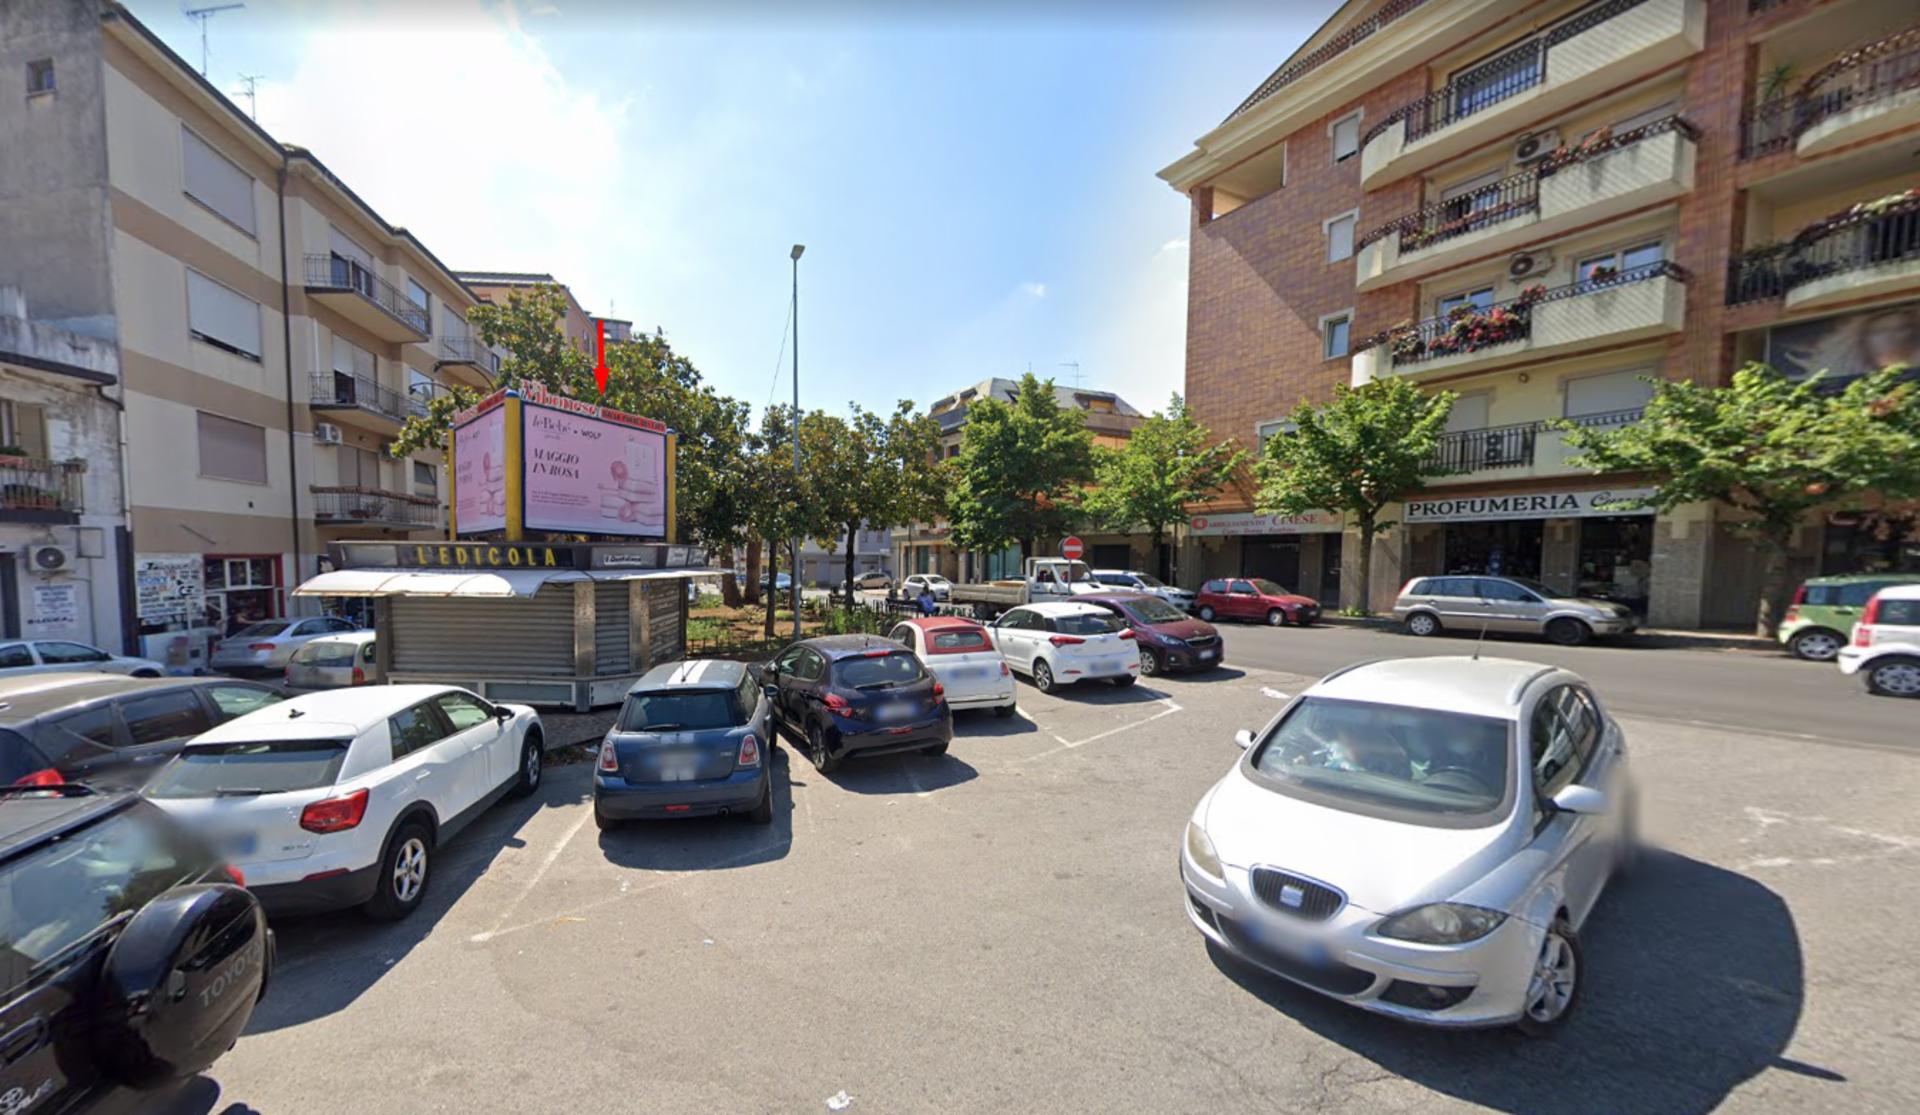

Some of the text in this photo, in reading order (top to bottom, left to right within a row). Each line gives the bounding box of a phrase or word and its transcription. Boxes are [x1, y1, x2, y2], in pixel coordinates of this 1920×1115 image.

[534, 447, 580, 465] MAGGIO
[532, 462, 580, 480] IN ROSA
[1408, 494, 1580, 516] PROFUMERIA
